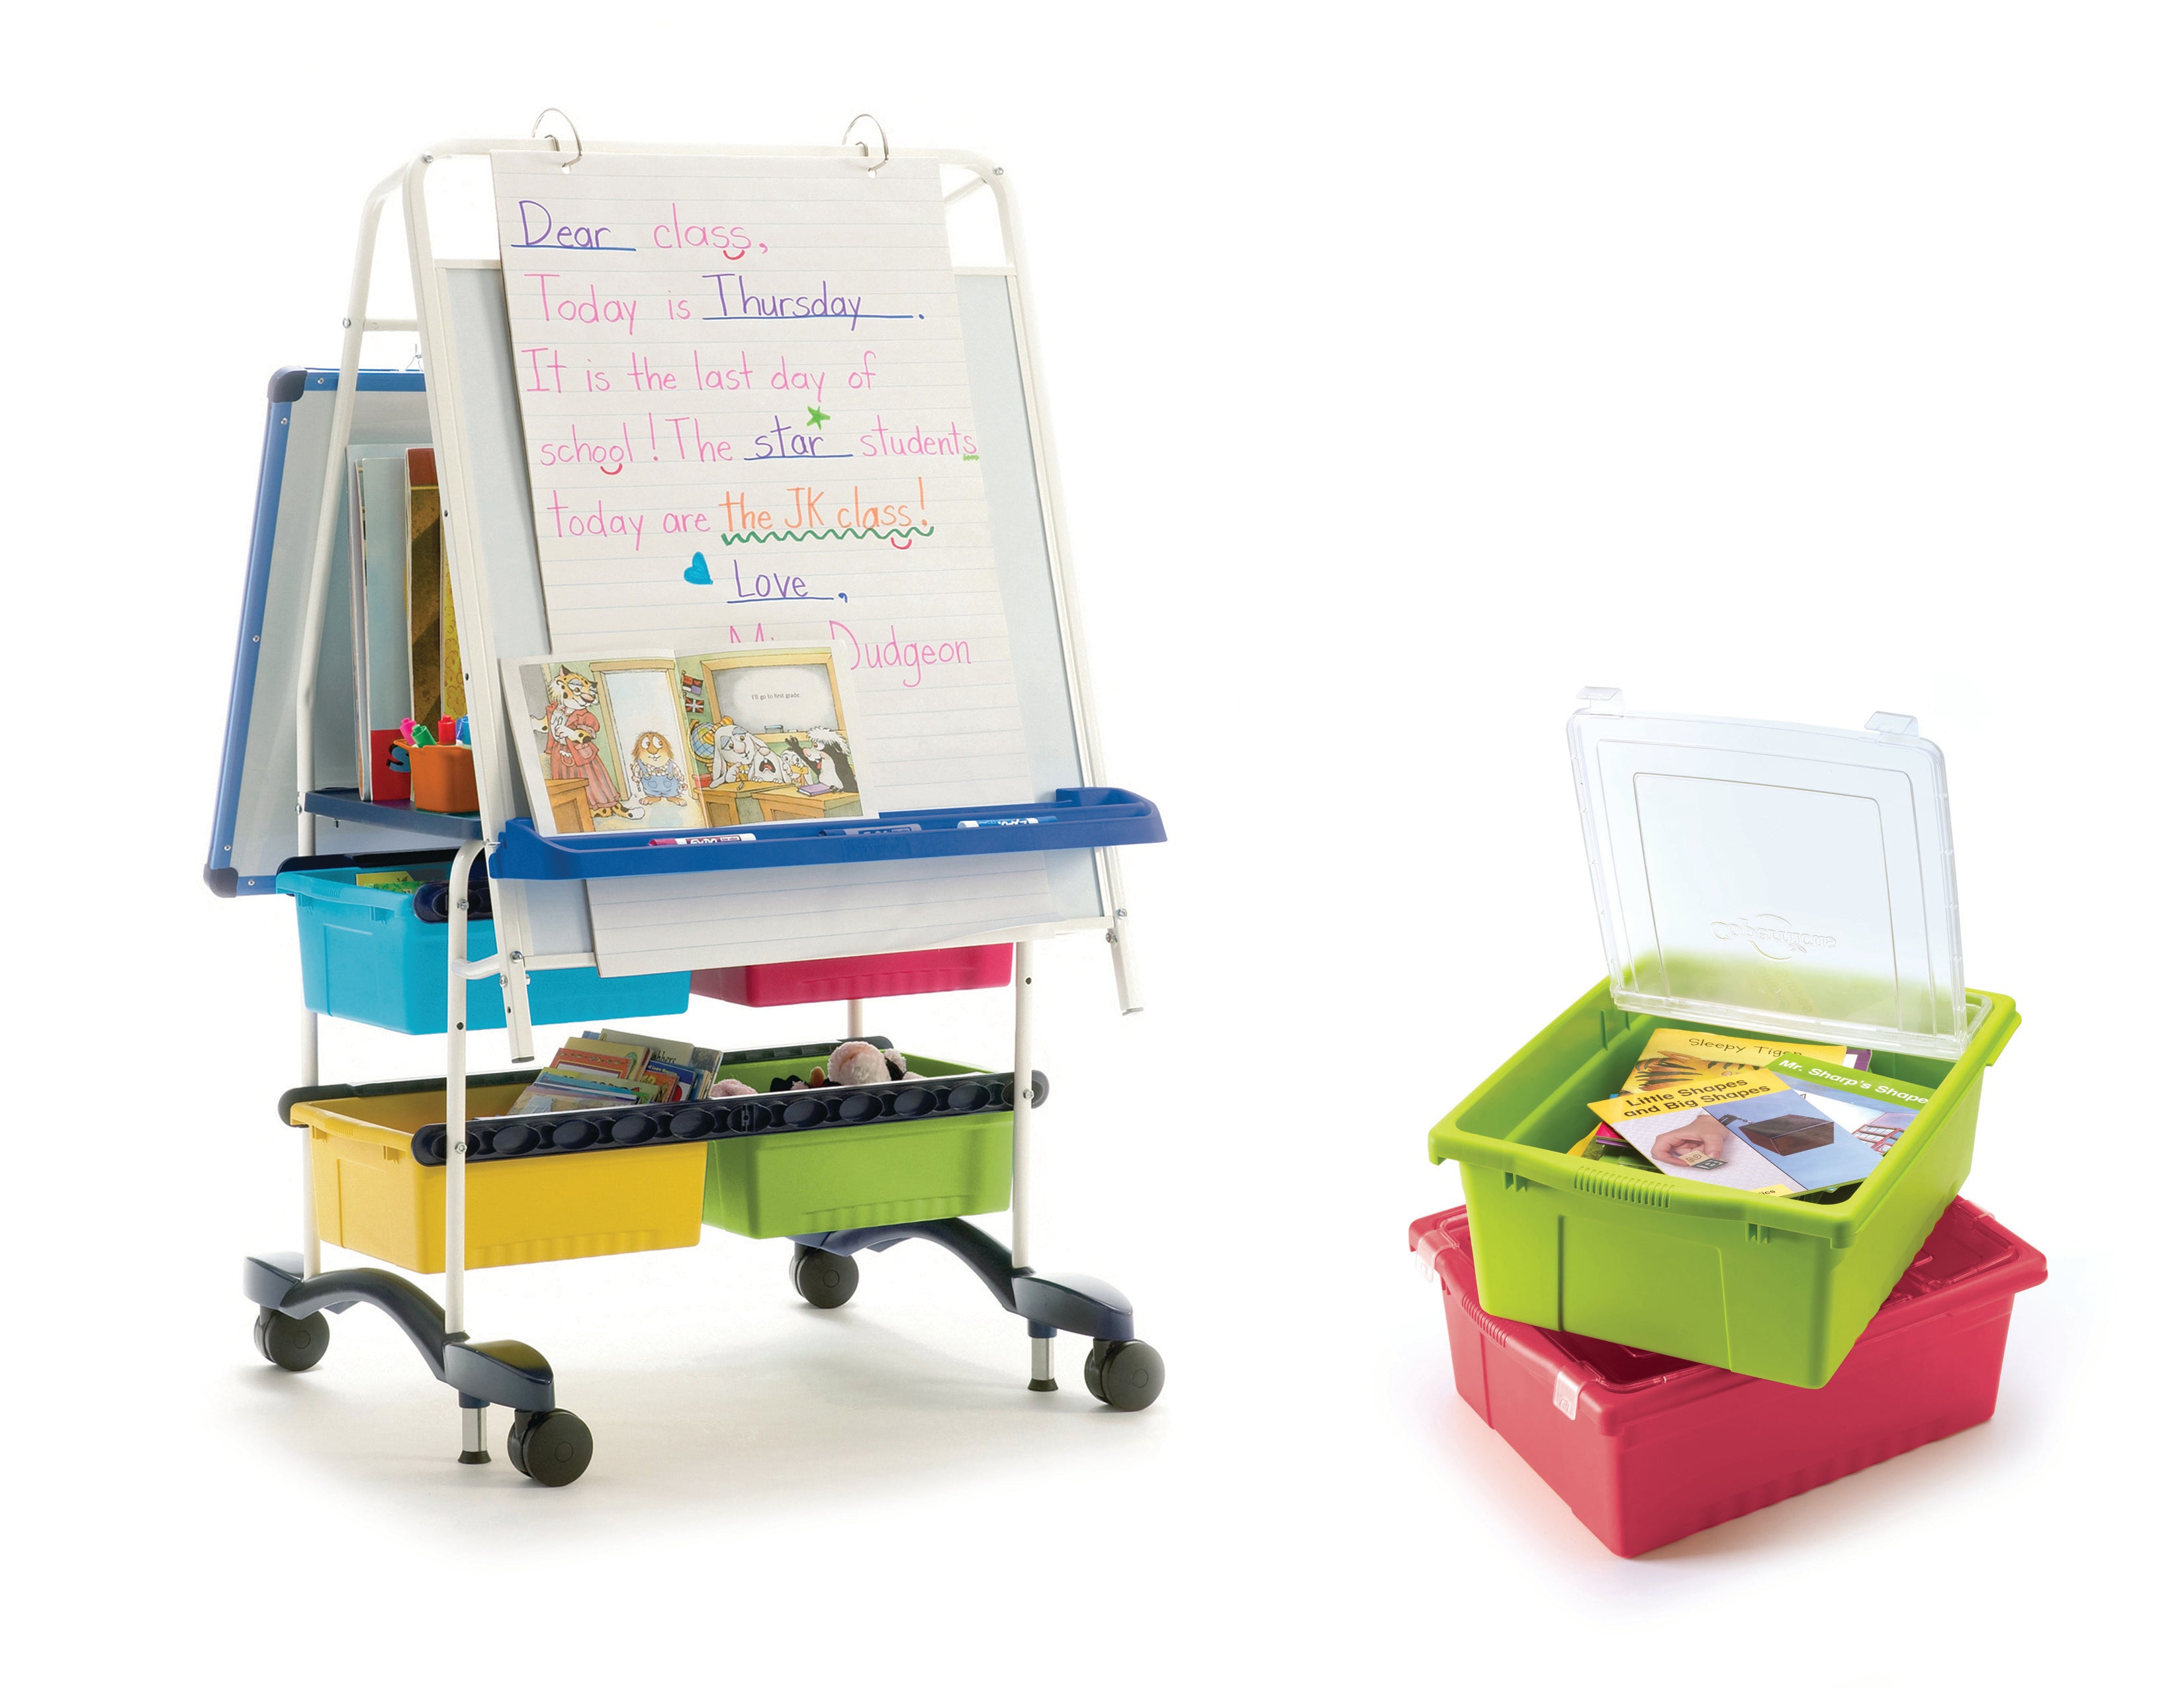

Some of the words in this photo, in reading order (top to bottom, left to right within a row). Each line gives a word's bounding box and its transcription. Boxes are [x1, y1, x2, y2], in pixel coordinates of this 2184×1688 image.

[519, 200, 611, 247] Dear
[654, 203, 768, 254] class,
[524, 273, 637, 336] Today
[668, 290, 691, 320] is
[702, 273, 861, 331] Thursday
[521, 347, 567, 393] It
[586, 359, 611, 393] is
[627, 352, 677, 391] the
[694, 350, 753, 390] last
[771, 356, 825, 402] day
[848, 350, 876, 389] of
[665, 417, 733, 462] The
[754, 416, 824, 458] star
[860, 415, 978, 457] students
[546, 490, 644, 551] today
[662, 512, 711, 533] are
[718, 491, 774, 531] the
[784, 487, 825, 528] JK
[837, 476, 928, 530] class!
[734, 560, 809, 598] Love
[1689, 1038, 1747, 1053] Sleepy
[1625, 1094, 1675, 1107] Little
[1678, 1079, 1748, 1097] Shapes
[1779, 1059, 1803, 1072] Mr.
[1808, 1068, 1872, 1090] Sharp's
[1623, 1105, 1661, 1117] and
[1664, 1098, 1698, 1111] Big
[1700, 1085, 1771, 1103] Shapes
